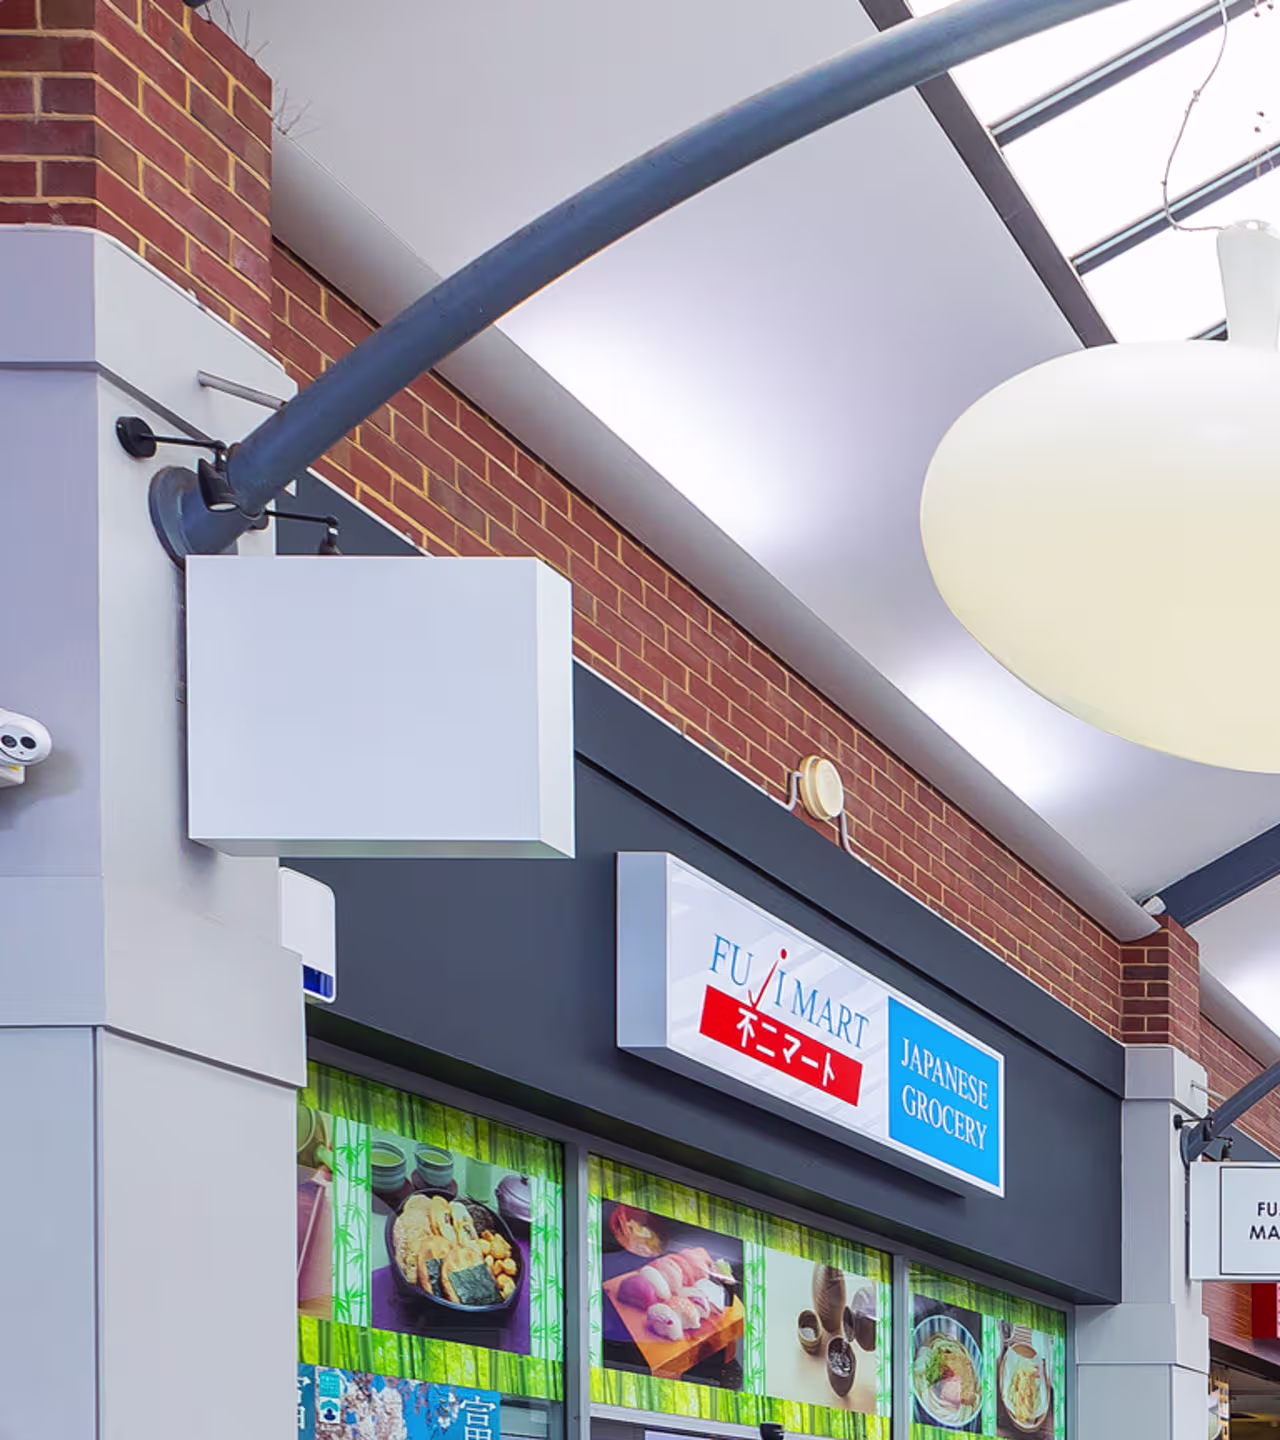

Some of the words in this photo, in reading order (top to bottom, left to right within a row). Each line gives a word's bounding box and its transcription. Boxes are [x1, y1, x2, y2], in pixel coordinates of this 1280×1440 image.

[708, 933, 787, 1010] FUJI
[791, 978, 870, 1049] MART
[736, 1006, 836, 1087] 不二マート
[901, 1037, 989, 1111] JAPANESE
[901, 1083, 988, 1151] GROCERY
